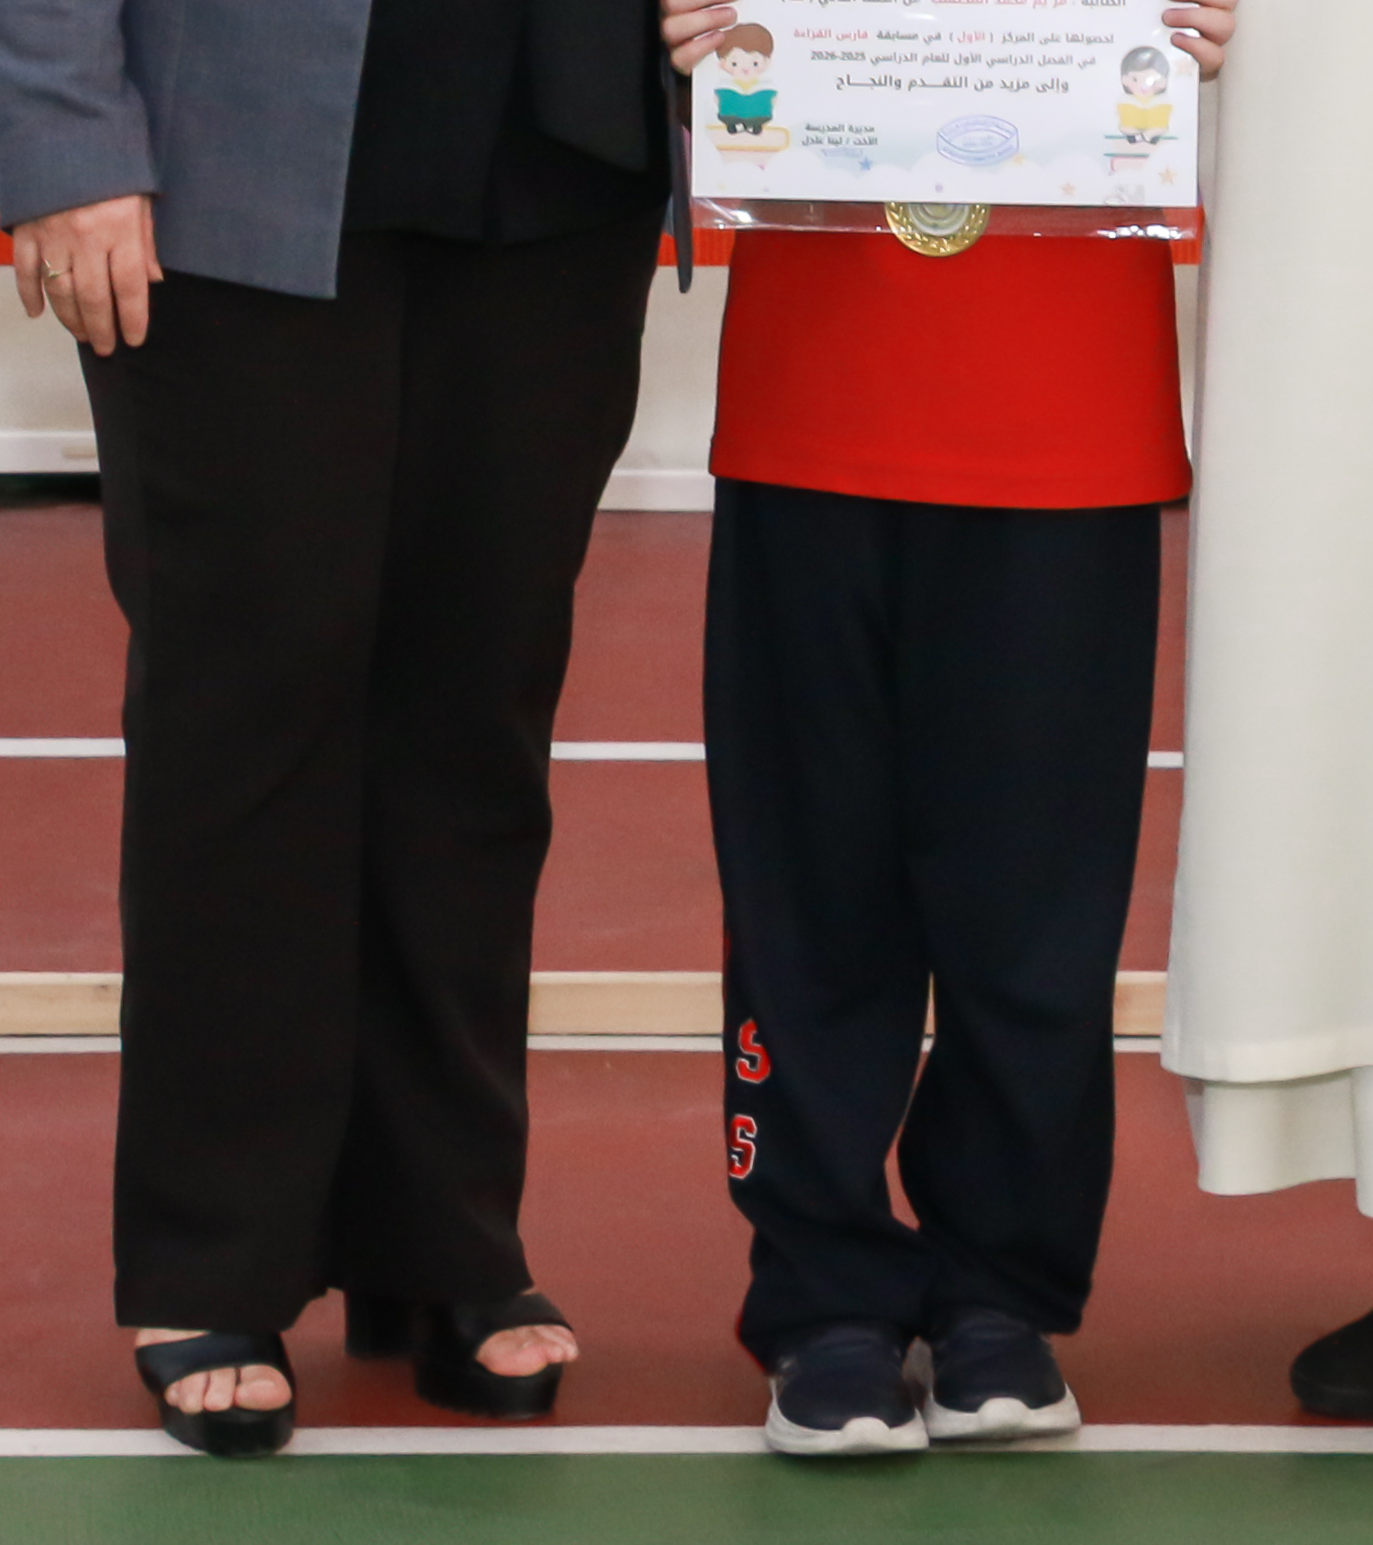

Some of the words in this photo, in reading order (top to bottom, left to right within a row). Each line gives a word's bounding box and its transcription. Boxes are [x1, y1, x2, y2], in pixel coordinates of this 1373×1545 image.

[973, 79, 995, 92] من
[999, 78, 1031, 93] مزيد
[1035, 76, 1070, 94] وإلى
